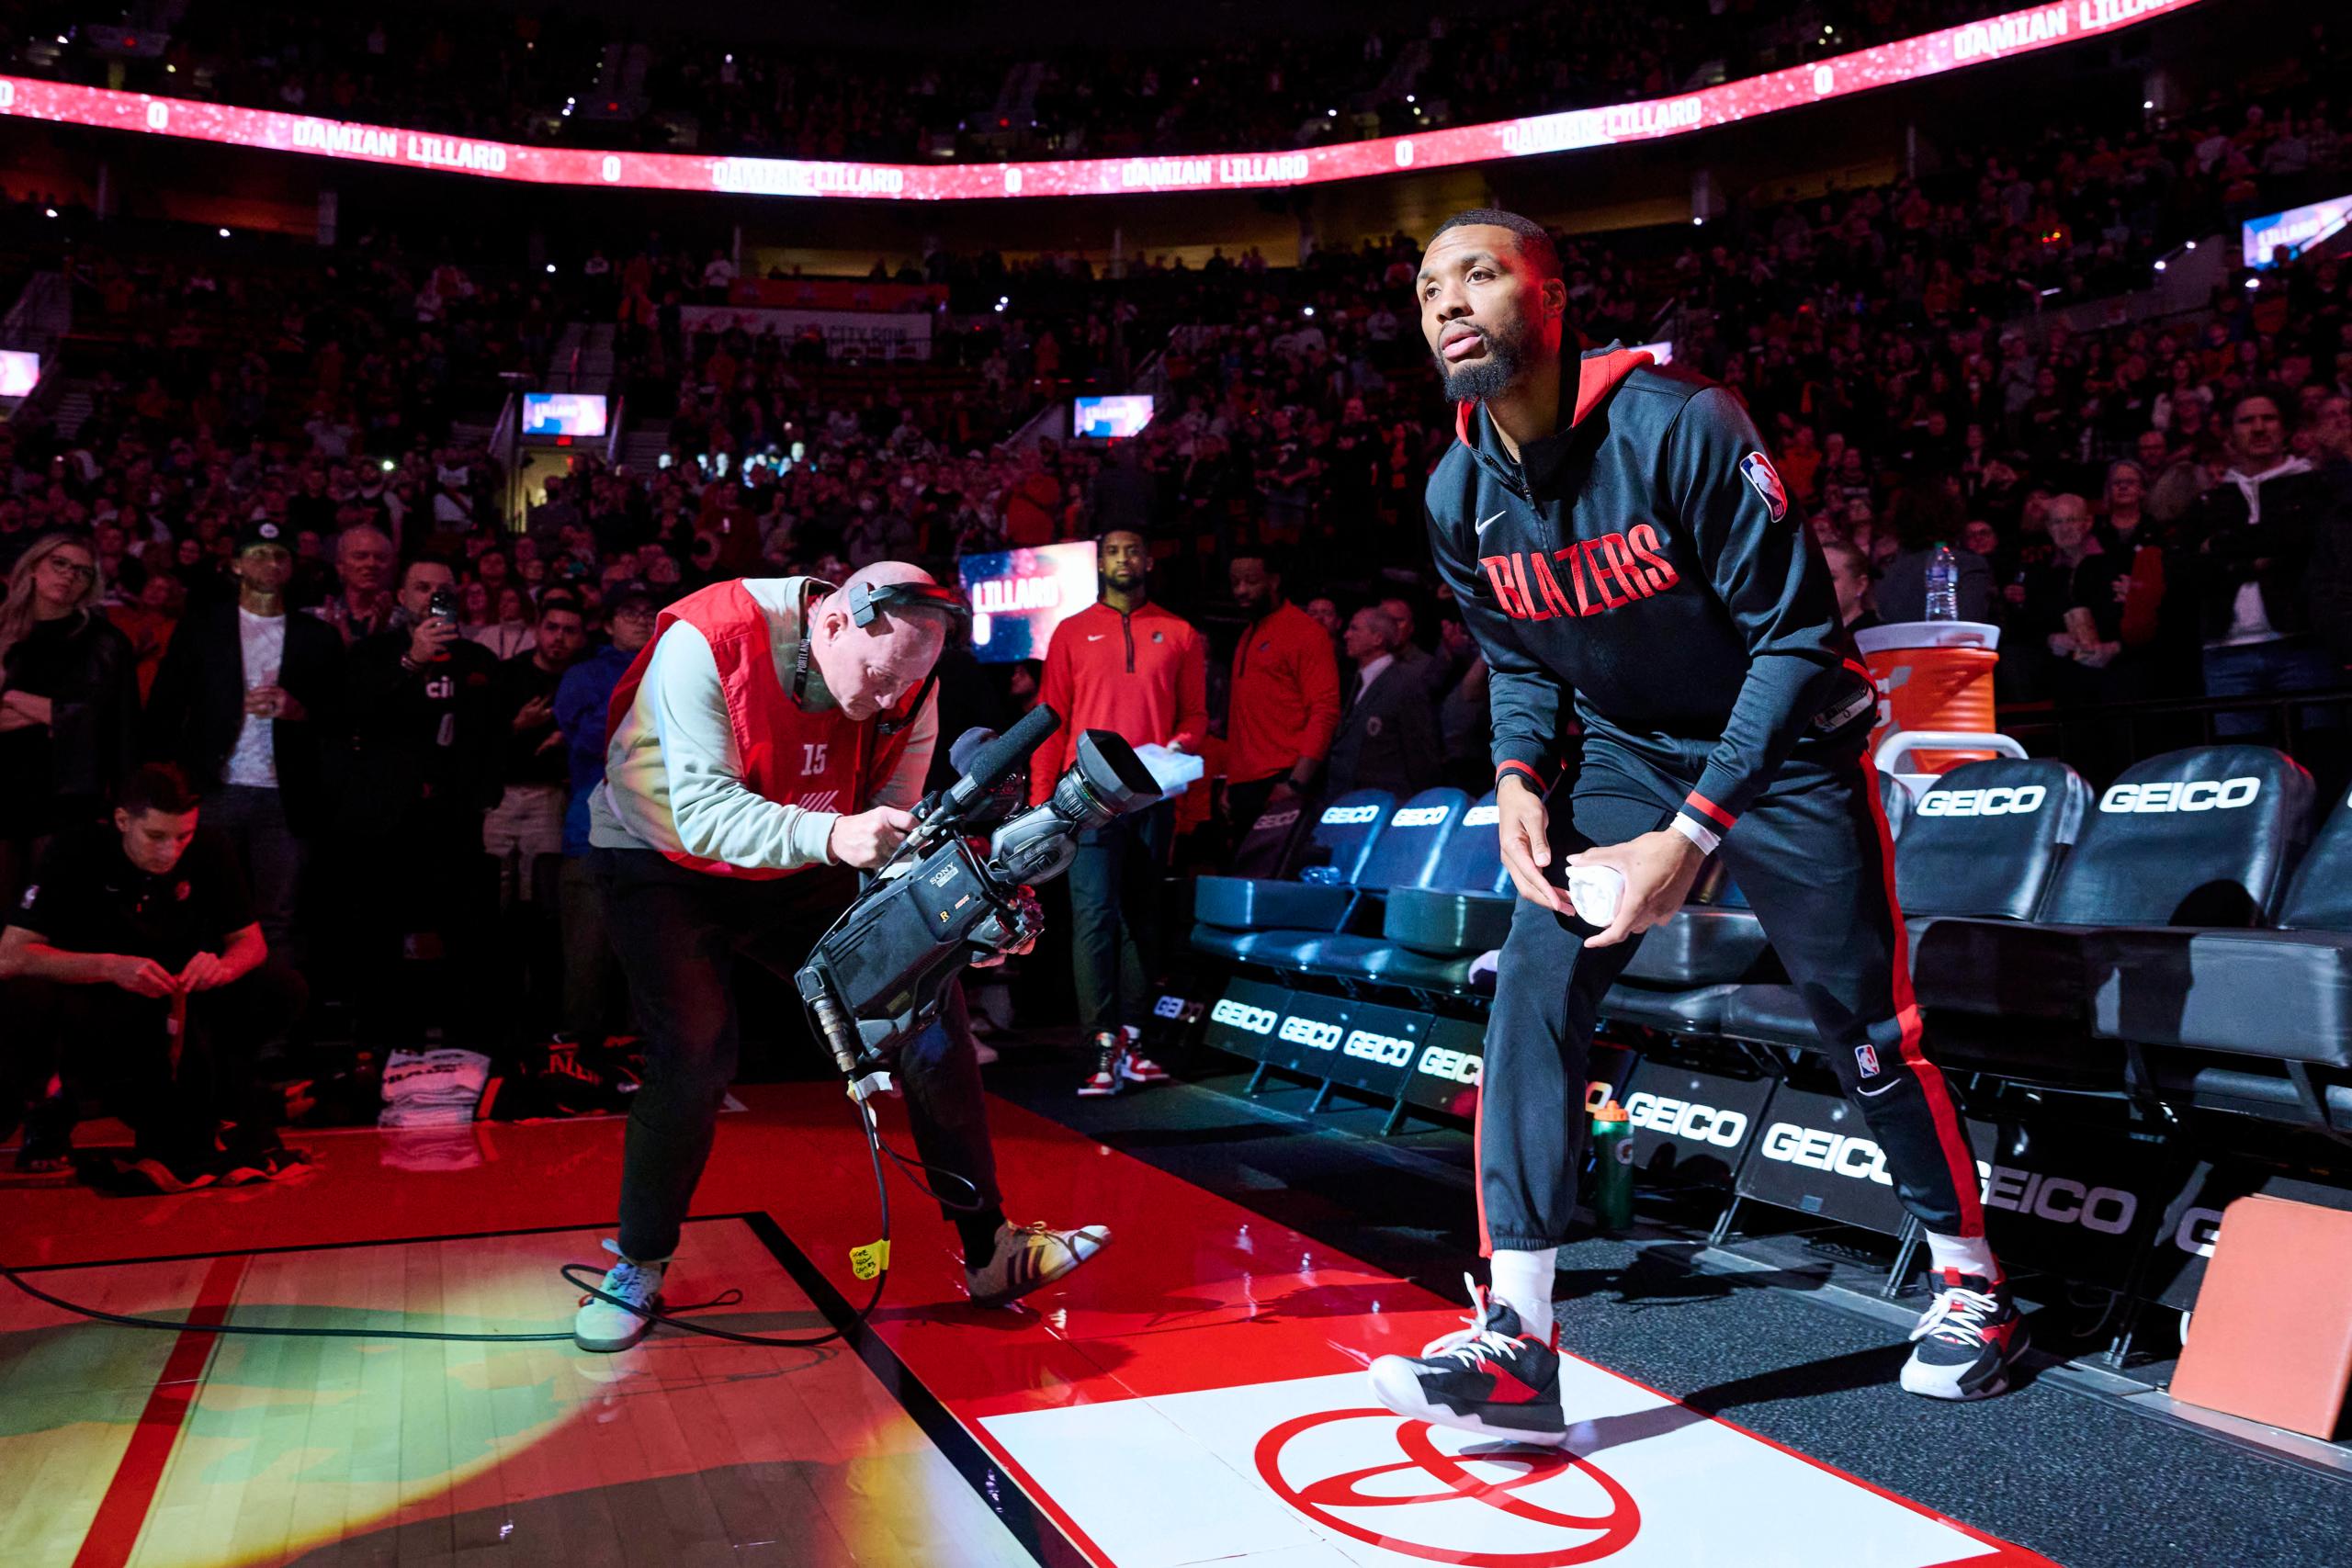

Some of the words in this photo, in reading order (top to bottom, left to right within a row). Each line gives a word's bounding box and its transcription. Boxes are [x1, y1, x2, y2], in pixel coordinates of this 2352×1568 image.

[1953, 6, 2066, 60] DAMIAN
[2079, 0, 2174, 29] LILL
[1814, 65, 1833, 95] 0
[147, 101, 168, 130] 0
[1606, 96, 1702, 137] LILLARD
[292, 120, 397, 158] DAMIAN
[407, 135, 506, 172] LILLARD
[1395, 140, 1414, 166] 0
[602, 155, 621, 182] 0
[815, 165, 903, 193] LILLARD
[1004, 167, 1023, 193] 0
[1122, 160, 1211, 187] DAMIAN
[1220, 154, 1308, 184] LILLARD
[1478, 524, 1680, 621] BLAZERS
[972, 575, 1059, 613] LILLARD
[796, 638, 810, 673] PORTLAND
[801, 744, 828, 776] 15
[1916, 785, 2047, 817] GEICO
[2099, 777, 2260, 814] GEICO
[1252, 809, 1301, 829] GEICO
[1320, 805, 1379, 824] GEICO
[1391, 806, 1449, 827] GEICO
[930, 862, 954, 885] SONY
[1211, 998, 1278, 1035] GEICO
[1278, 1016, 1343, 1051] GEICO
[1343, 1030, 1415, 1067] GEICO
[1418, 1045, 1484, 1087] GEIC
[1623, 1091, 1747, 1148] GEICO
